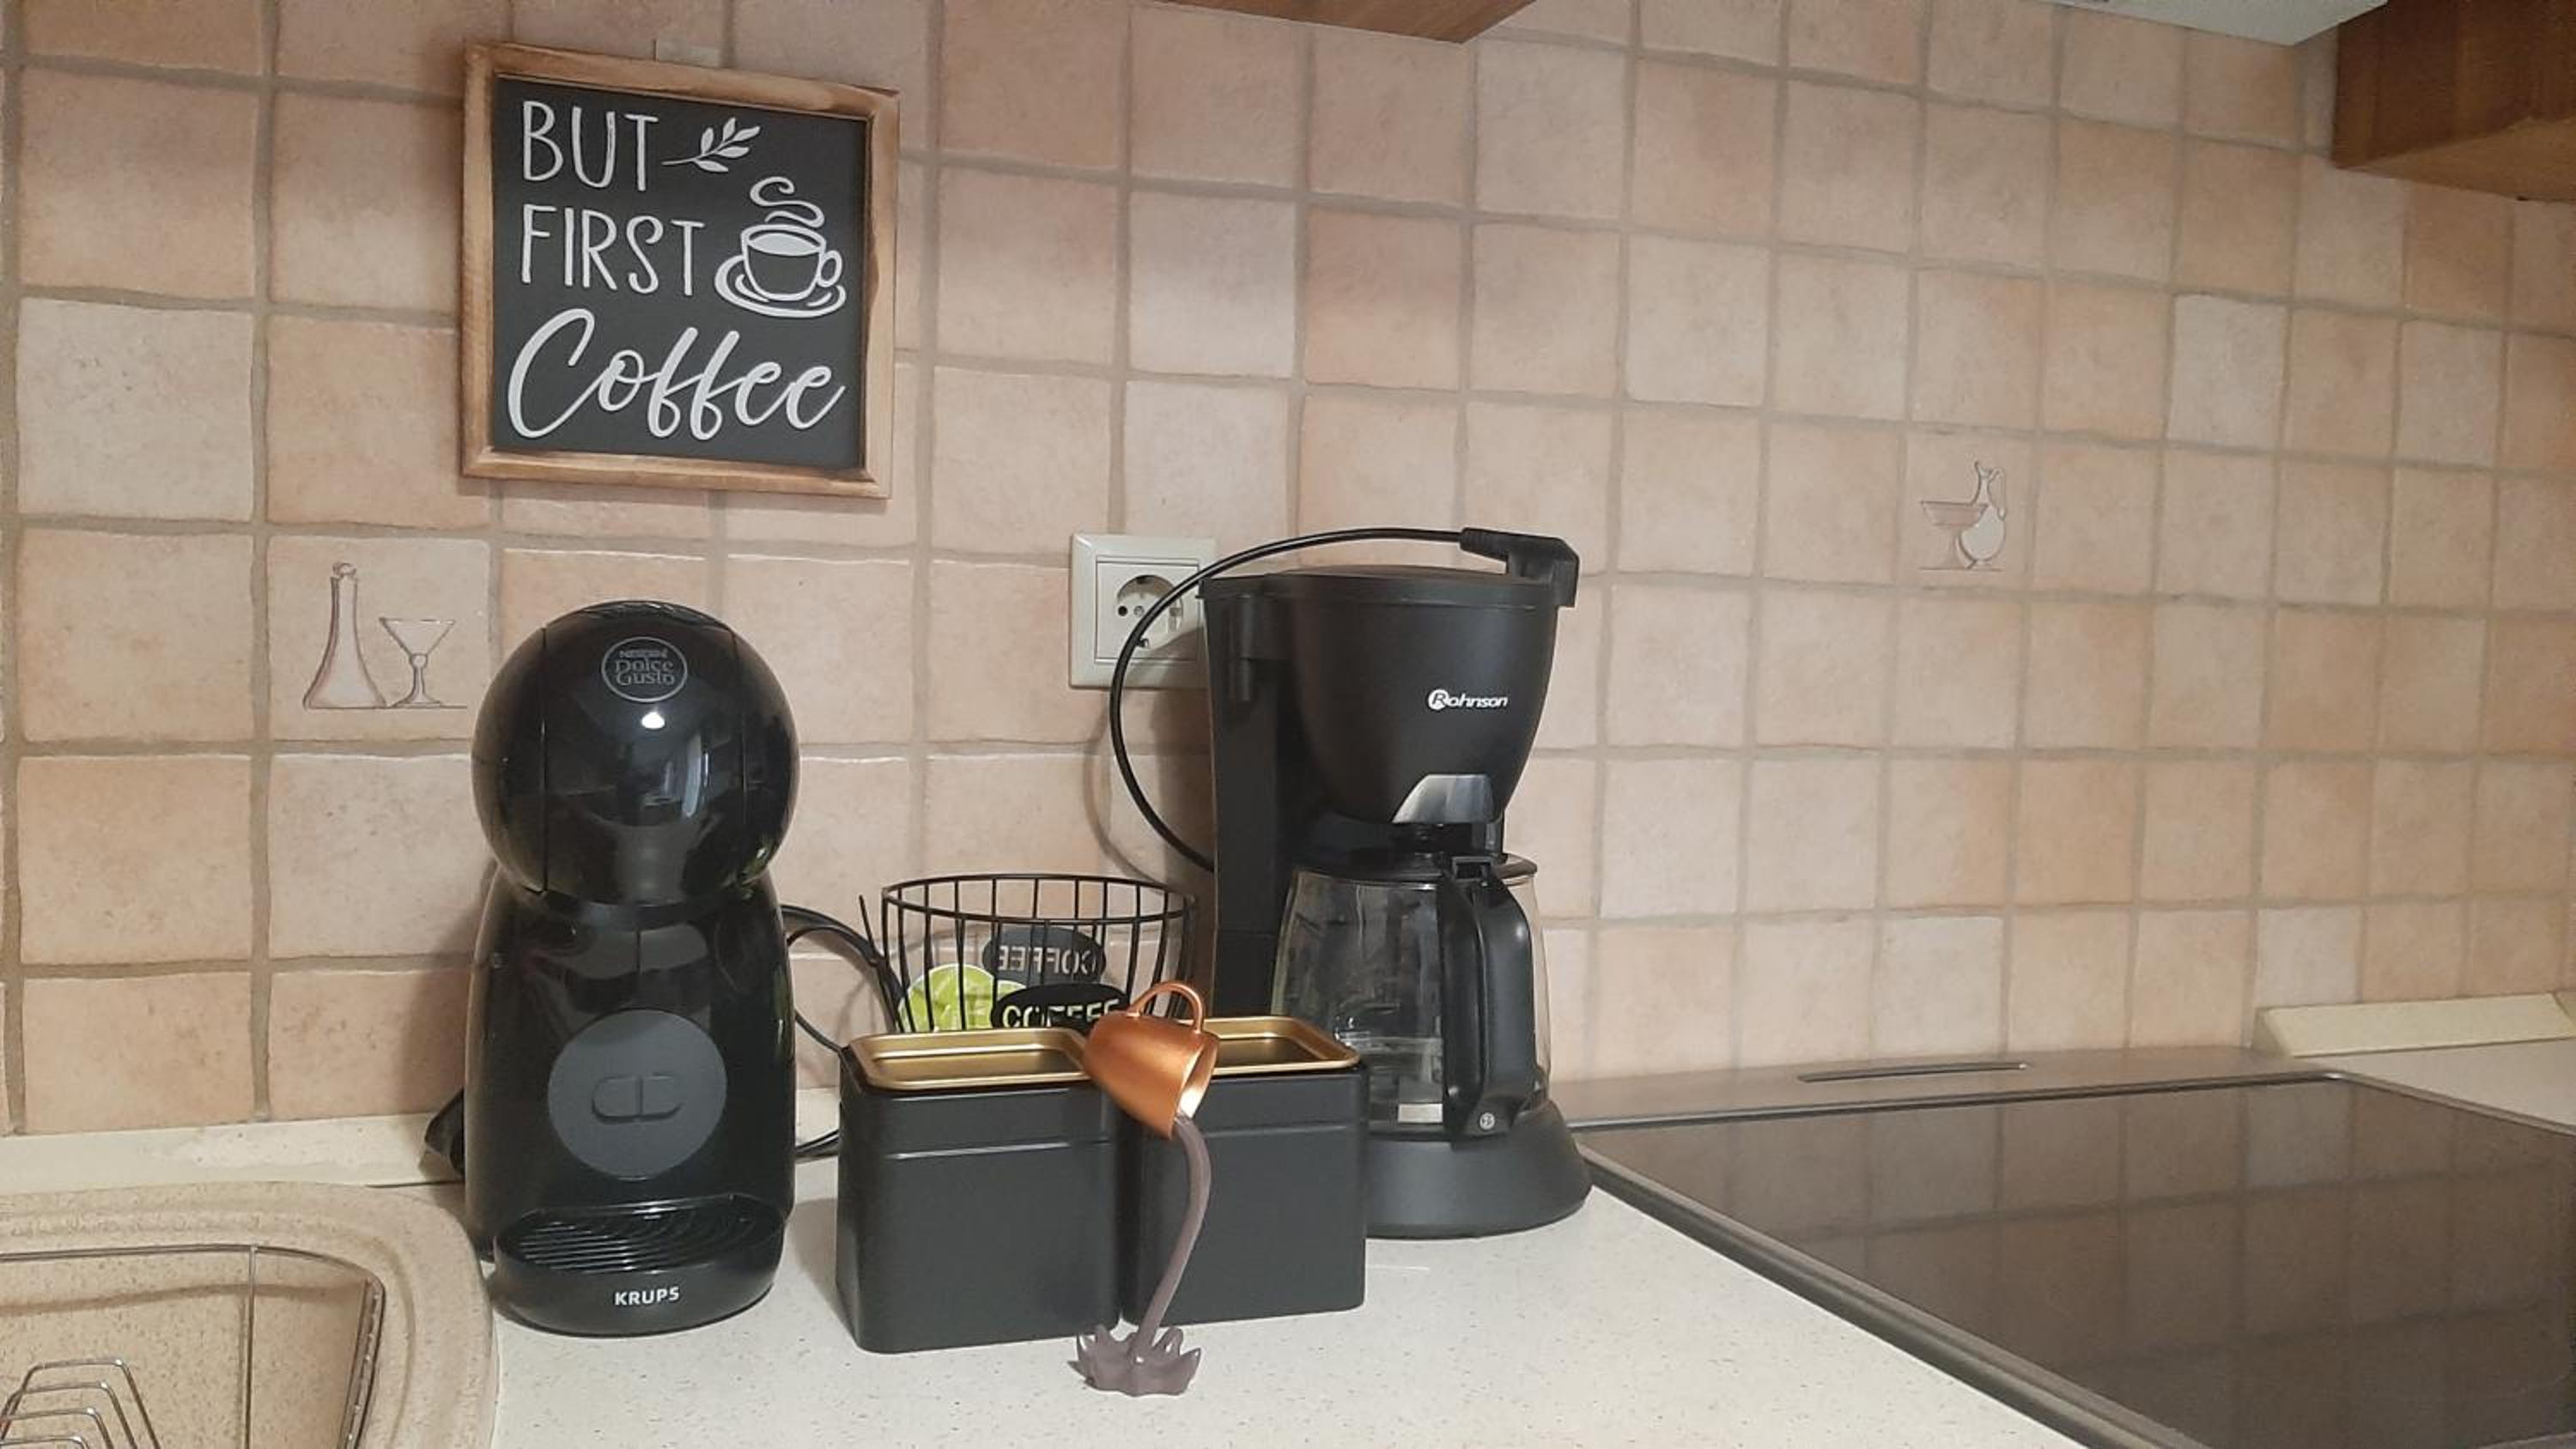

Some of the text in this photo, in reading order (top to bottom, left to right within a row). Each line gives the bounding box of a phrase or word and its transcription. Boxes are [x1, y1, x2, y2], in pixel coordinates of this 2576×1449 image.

[522, 100, 659, 191] BUT
[521, 203, 705, 295] FIRST
[507, 308, 846, 440] Coffee
[615, 658, 674, 673] Dolce
[616, 670, 676, 686] Gusto
[1427, 688, 1509, 711] Rohnson
[614, 1286, 680, 1306] KRUPS
